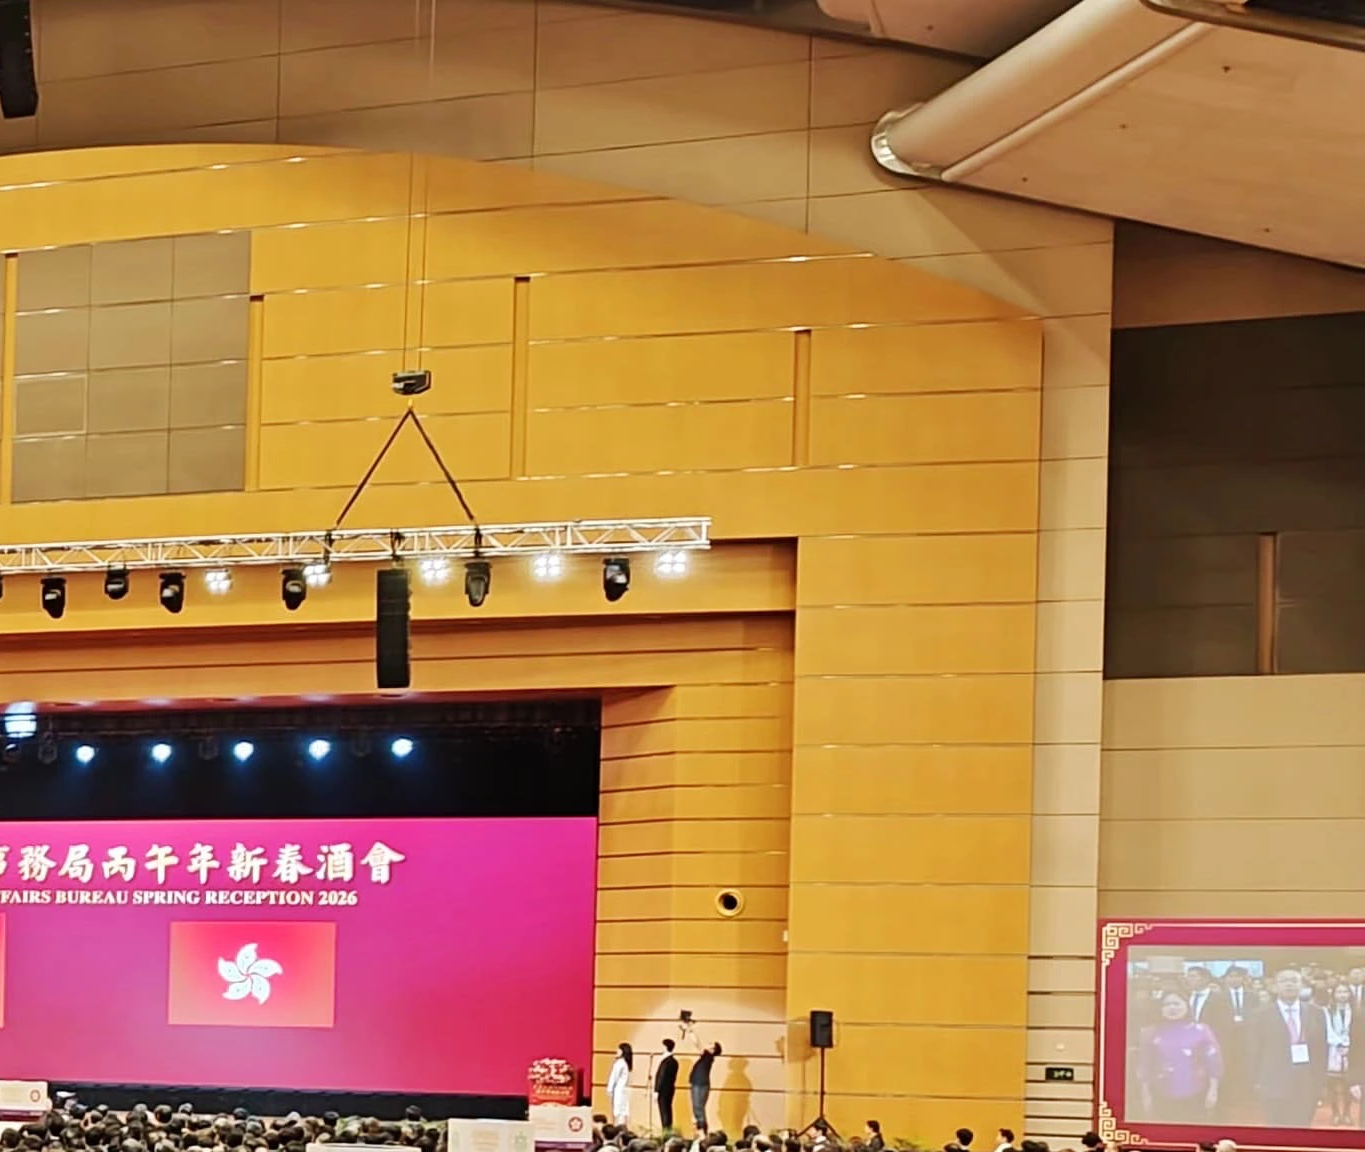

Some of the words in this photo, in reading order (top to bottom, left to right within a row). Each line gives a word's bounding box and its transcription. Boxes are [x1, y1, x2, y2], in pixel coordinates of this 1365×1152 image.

[55, 889, 129, 906] BUREAU
[132, 890, 200, 905] SPRING
[205, 890, 314, 906] RECEPTION
[318, 890, 358, 906] 2026
